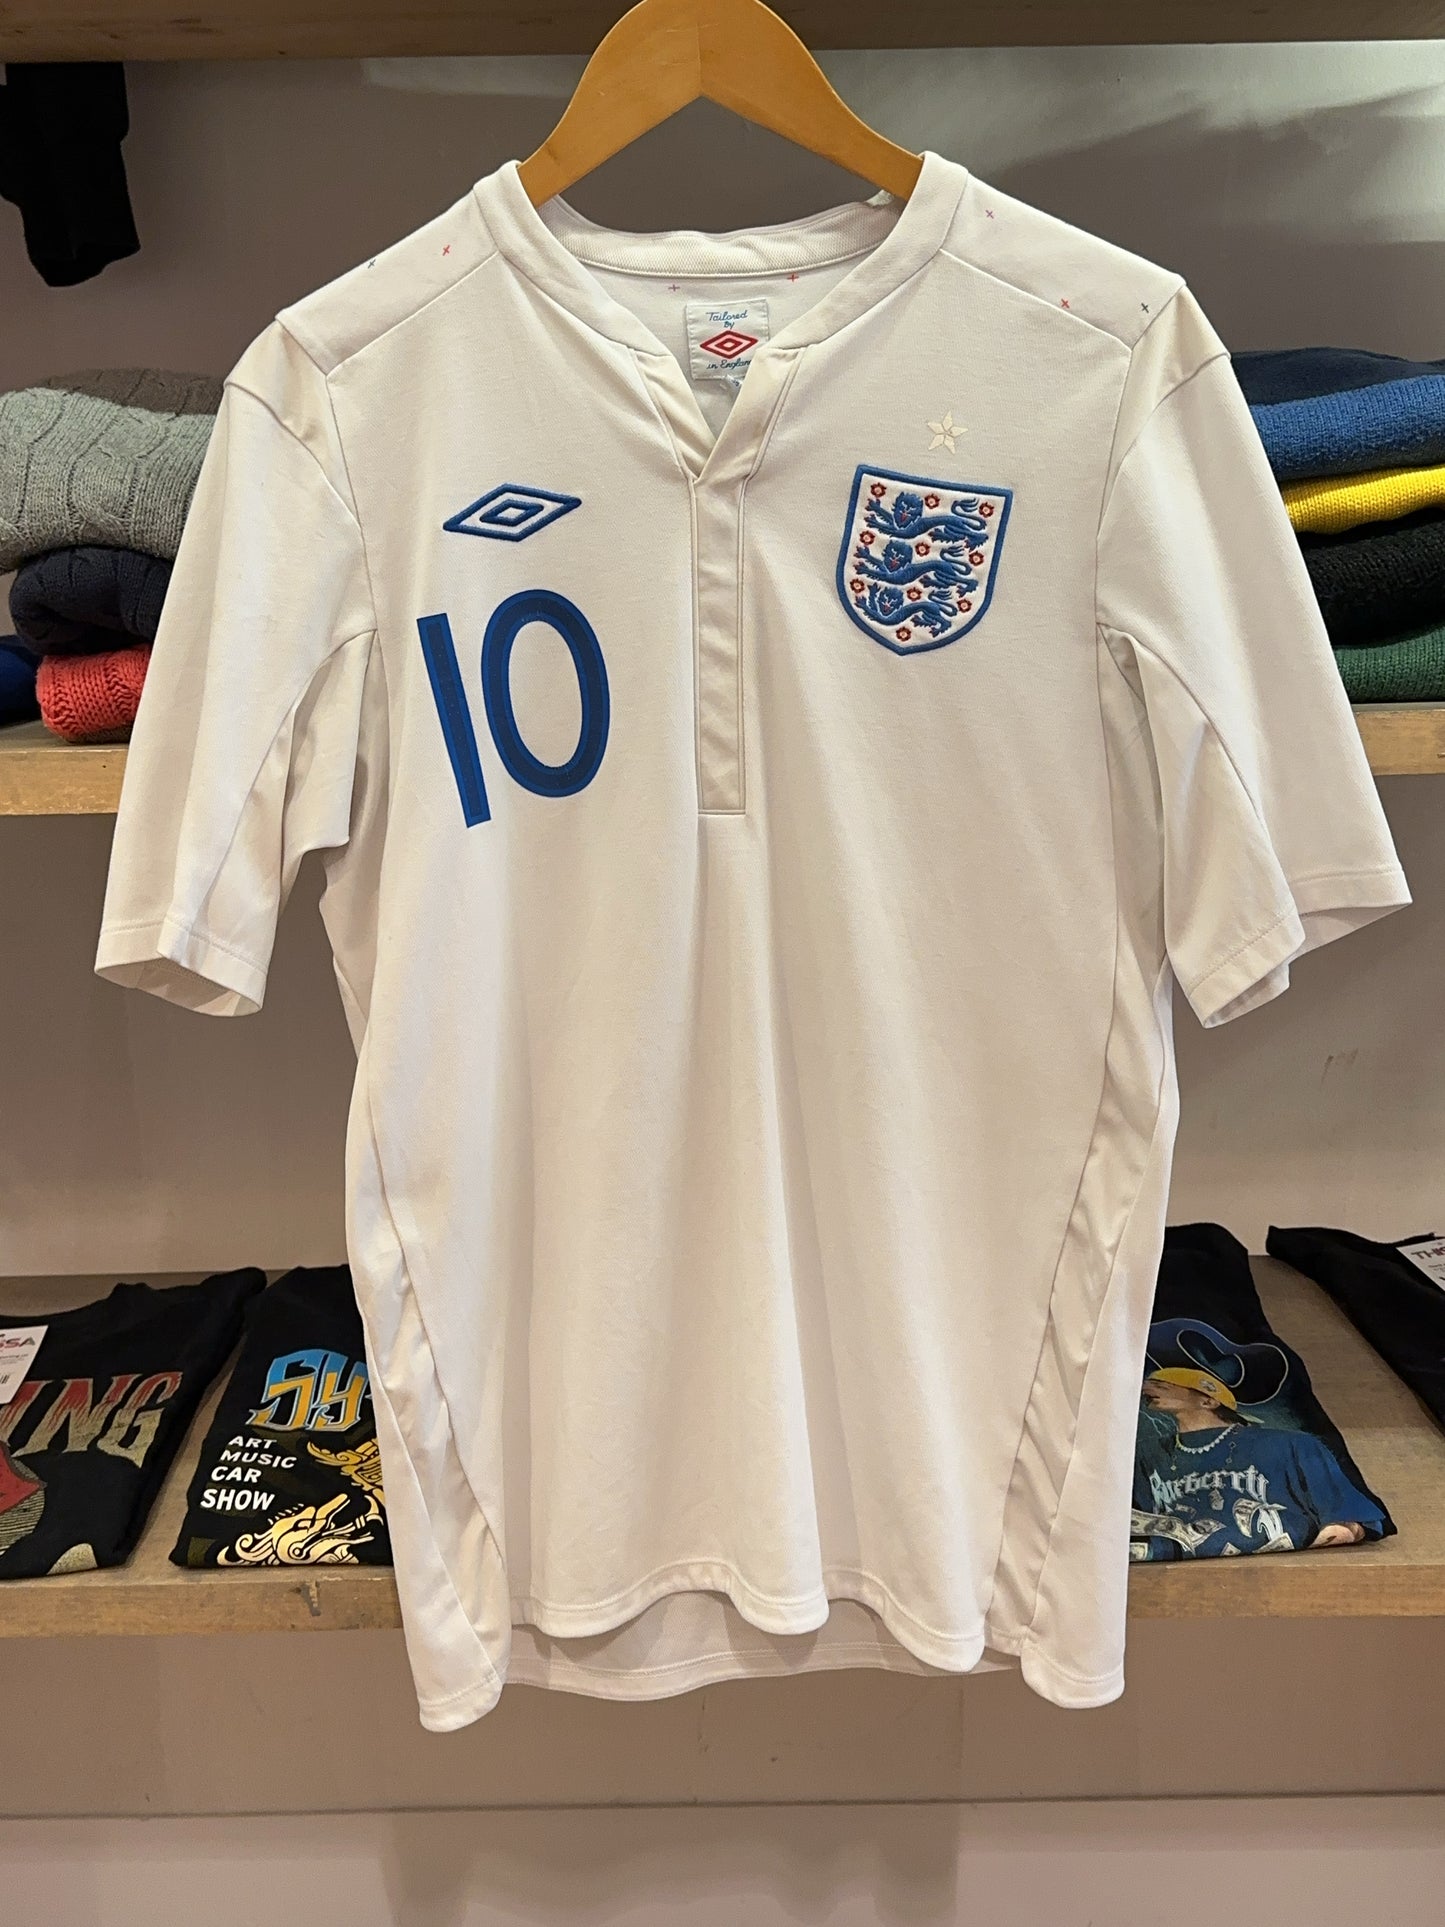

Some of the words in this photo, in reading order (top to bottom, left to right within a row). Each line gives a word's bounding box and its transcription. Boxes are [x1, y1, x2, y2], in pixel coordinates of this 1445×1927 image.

[705, 309, 748, 322] Tailored
[720, 358, 752, 370] Englan
[416, 589, 610, 828] 10
[228, 1435, 277, 1449] ART
[220, 1450, 297, 1469] MUSIC
[211, 1466, 262, 1483] CAR
[200, 1488, 275, 1511] SHOW
